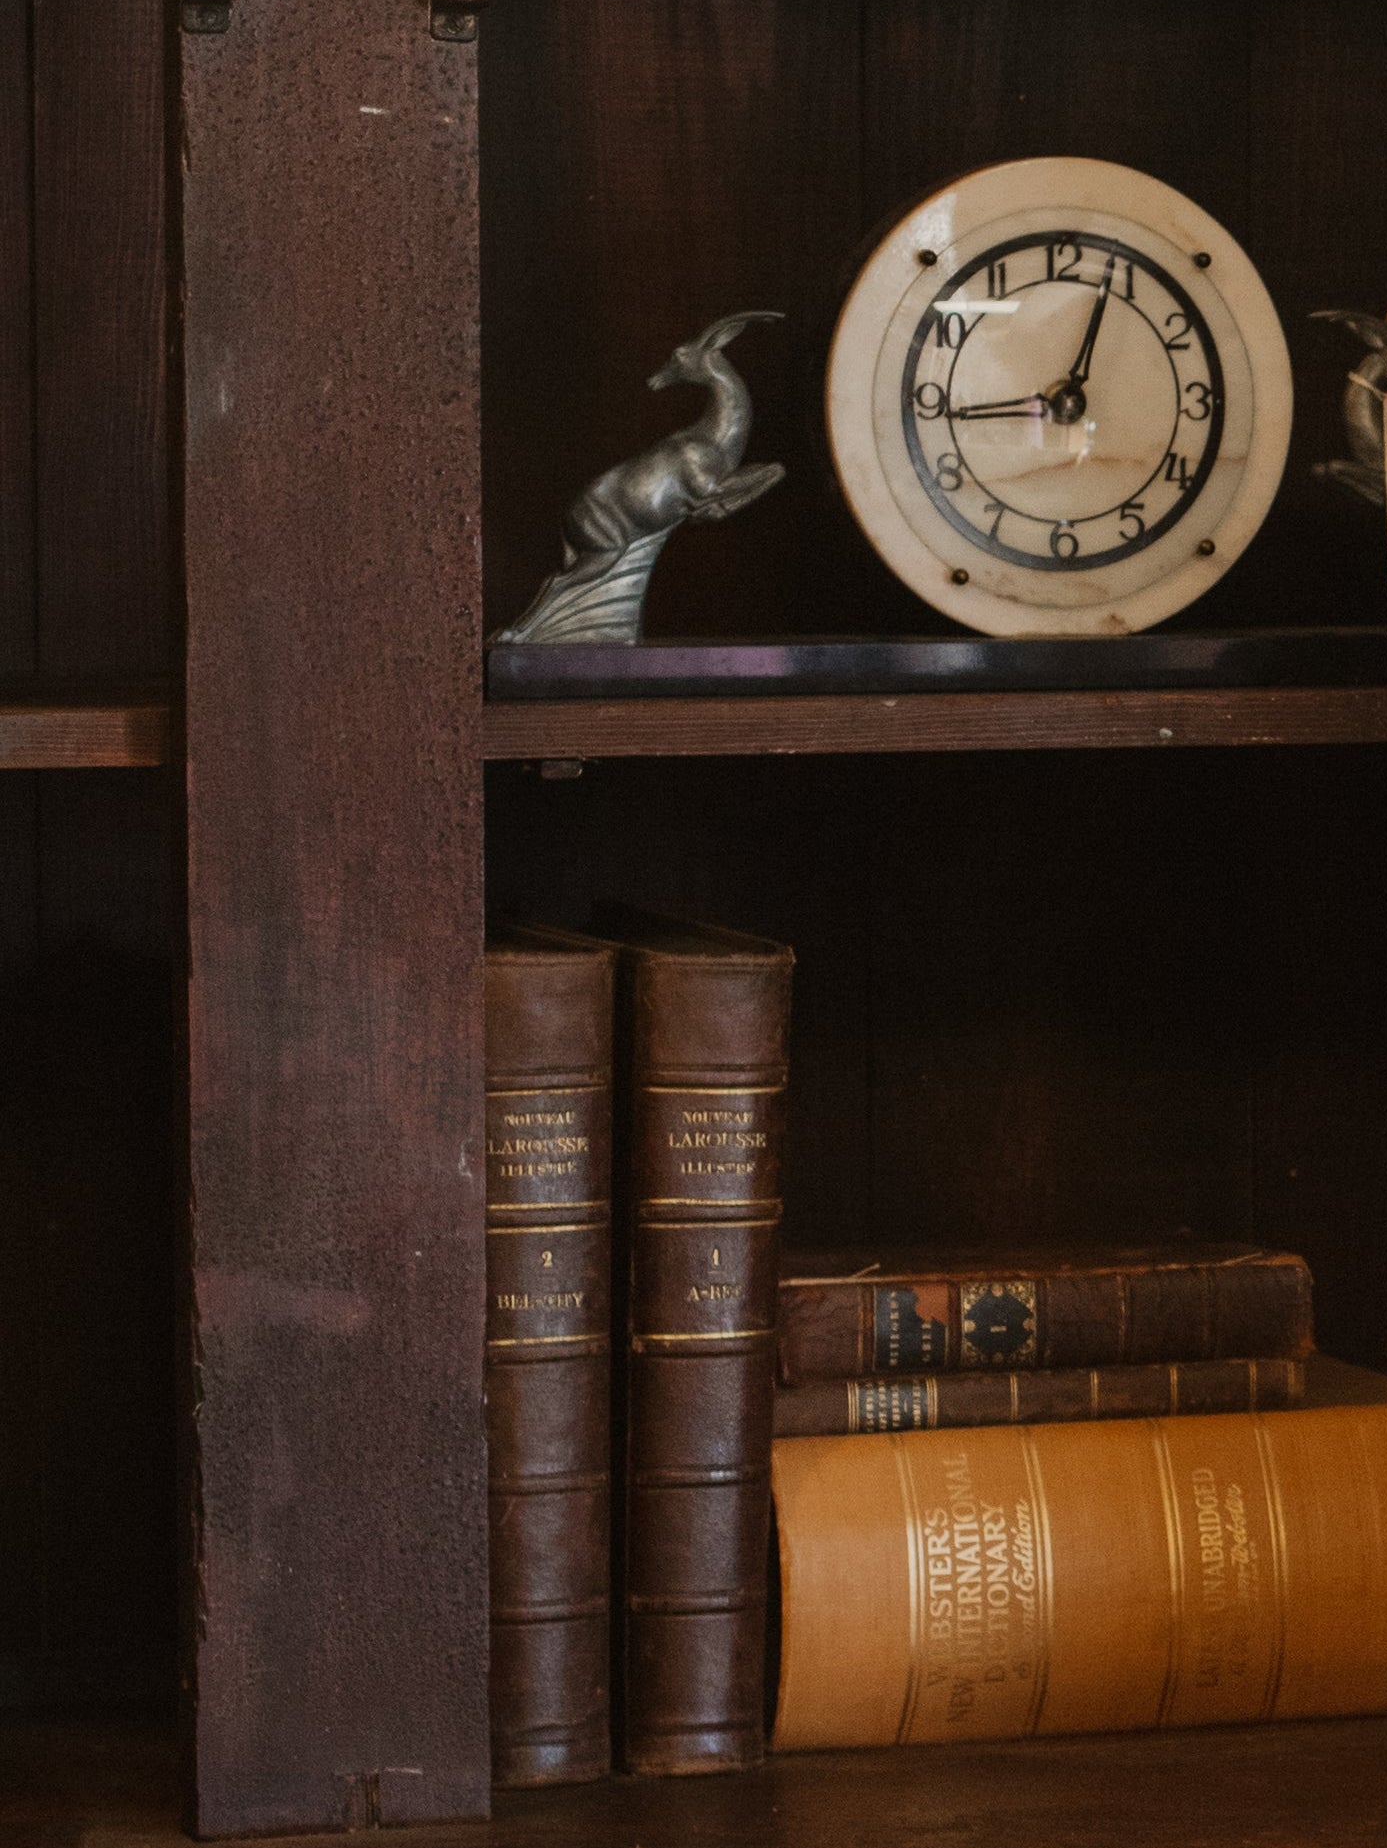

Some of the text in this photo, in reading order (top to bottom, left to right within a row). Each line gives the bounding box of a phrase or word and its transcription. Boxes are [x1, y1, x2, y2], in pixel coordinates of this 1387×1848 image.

[1044, 242, 1084, 282] 12
[1164, 314, 1192, 352] 2
[913, 385, 946, 421] 9
[1184, 383, 1214, 421] 3
[935, 456, 965, 492] 8
[1164, 452, 1194, 491] 4
[1050, 520, 1078, 561] 6
[1118, 503, 1146, 541] 5
[541, 1250, 554, 1269] 2
[1010, 1498, 1037, 1593] Edition
